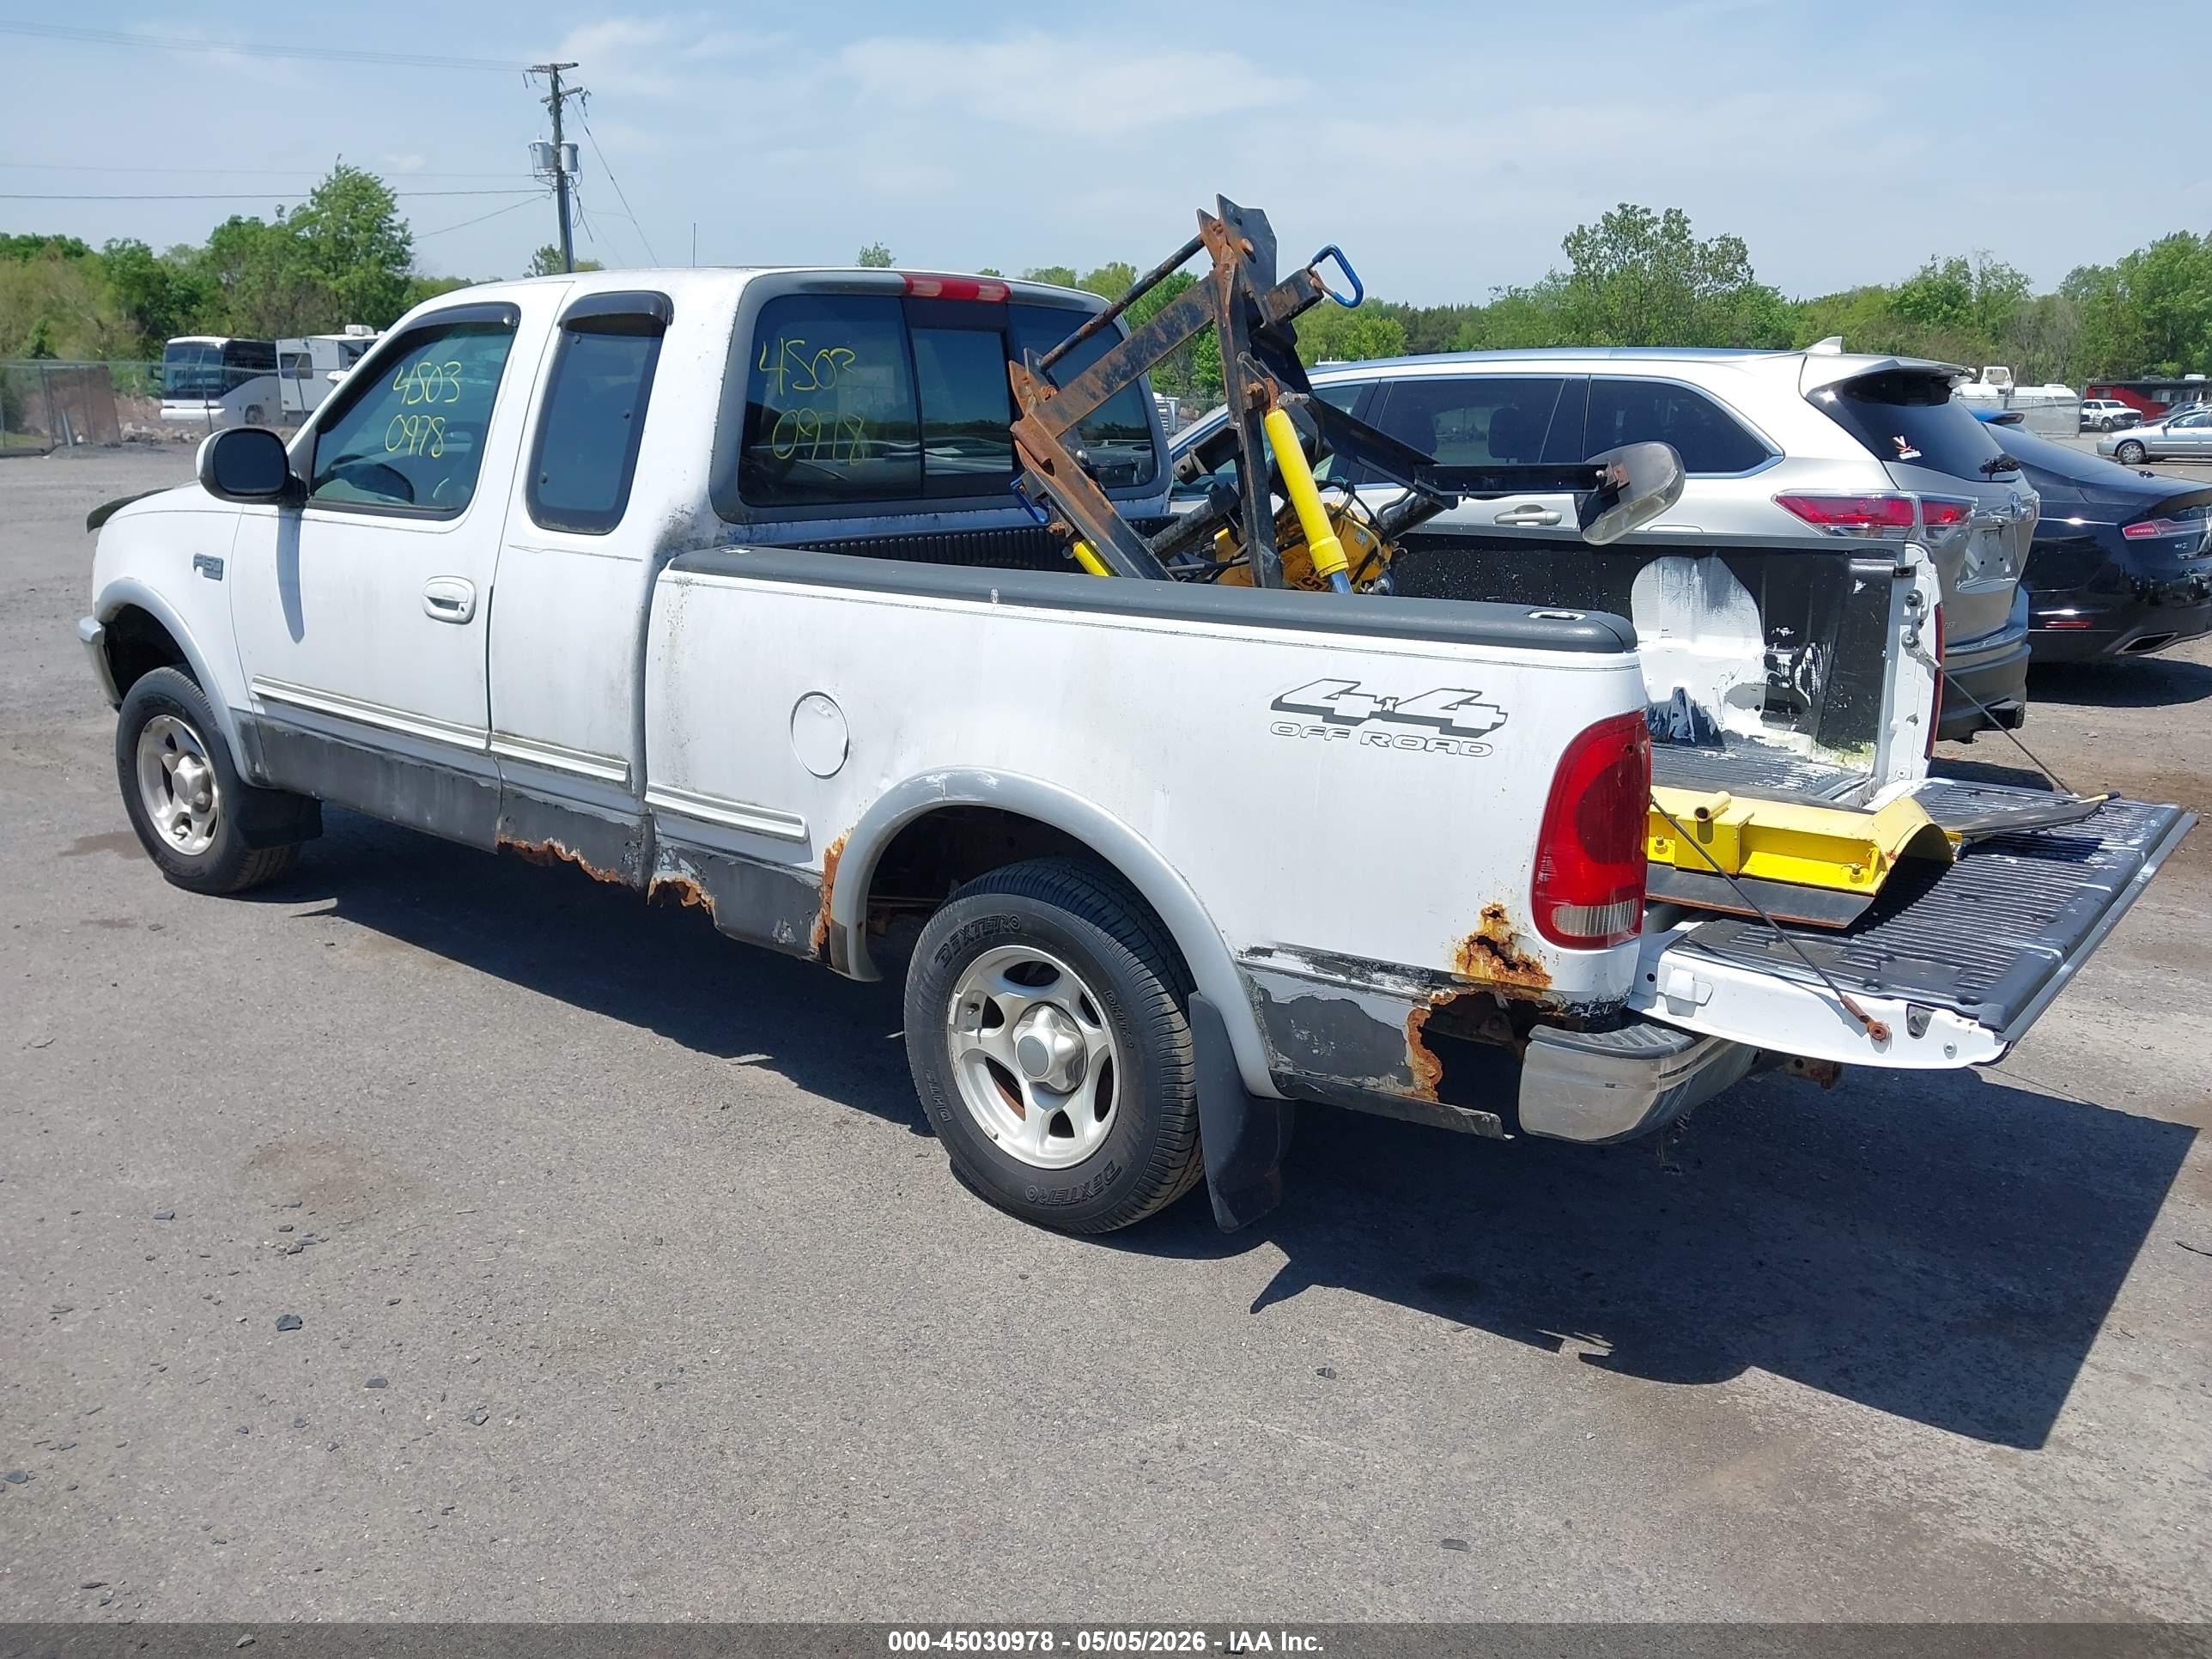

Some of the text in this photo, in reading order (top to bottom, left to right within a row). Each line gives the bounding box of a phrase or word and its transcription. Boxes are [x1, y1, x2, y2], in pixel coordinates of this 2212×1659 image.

[392, 361, 461, 405] 4503
[386, 414, 446, 458] 0978
[772, 407, 865, 465] 0978
[1269, 721, 1494, 757] OFF ROAD
[933, 913, 1022, 968] DEXTERO
[1024, 1159, 1122, 1206] DEXTERO
